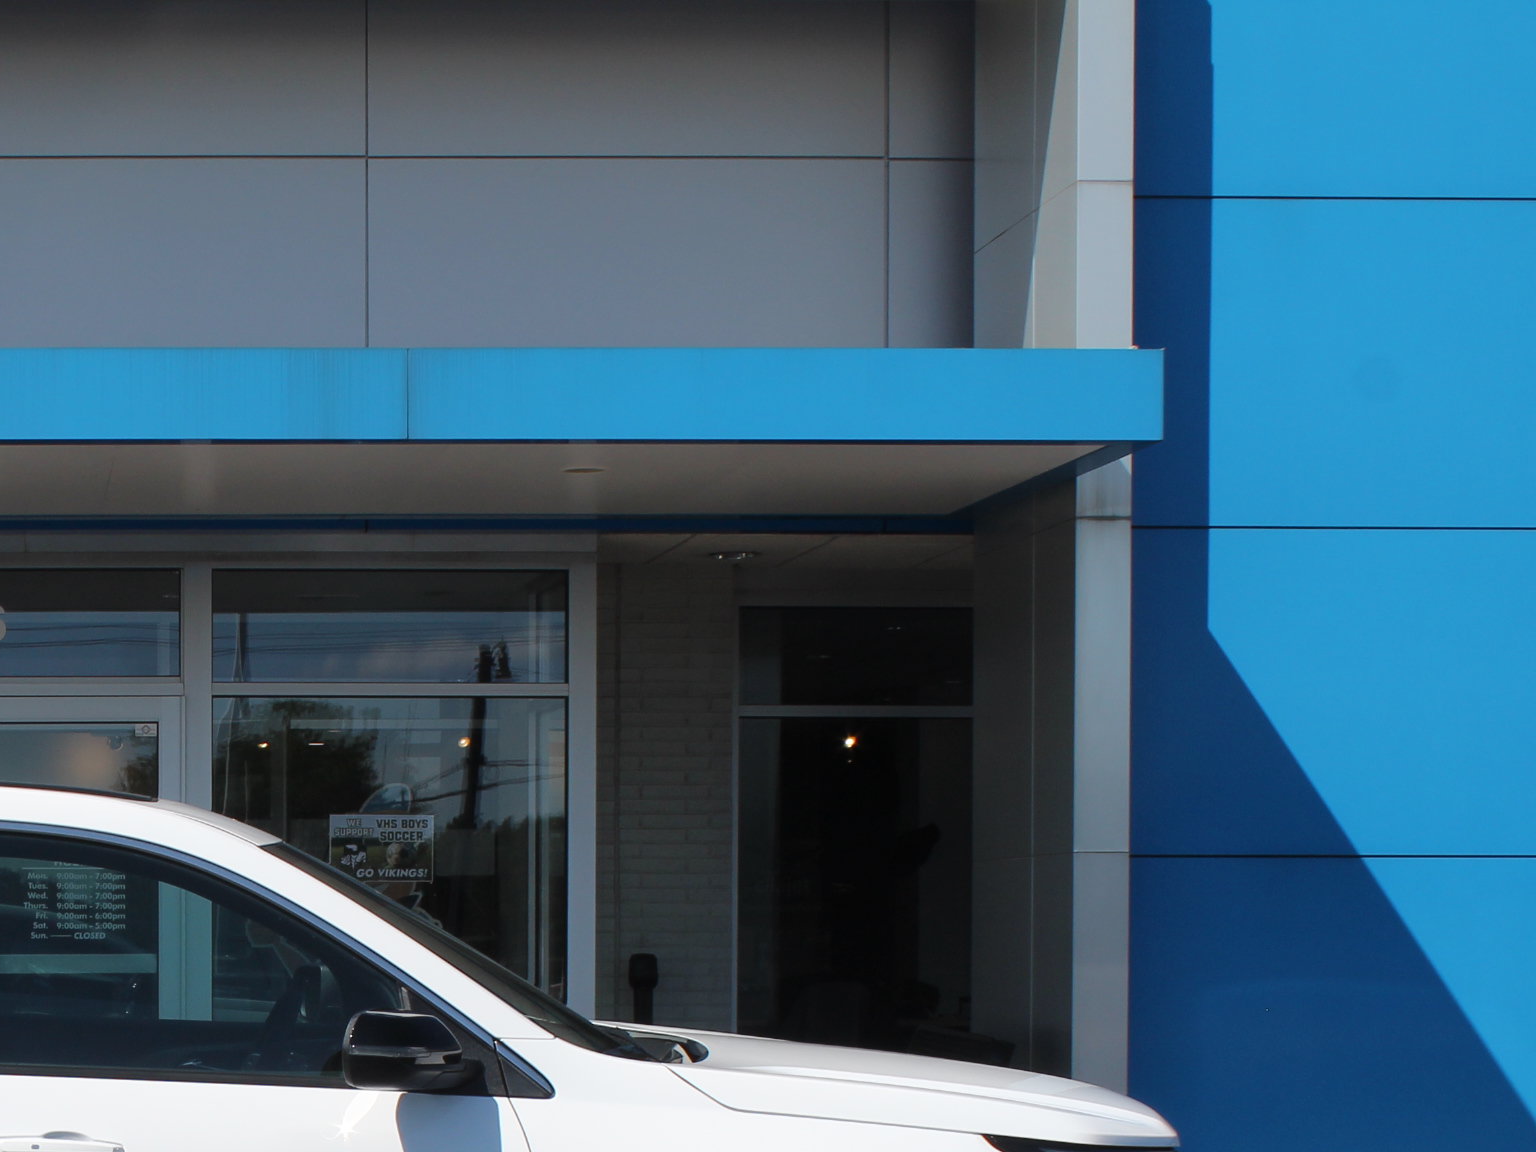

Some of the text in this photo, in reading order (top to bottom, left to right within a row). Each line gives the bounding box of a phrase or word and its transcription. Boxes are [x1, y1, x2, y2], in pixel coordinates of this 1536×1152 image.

[346, 818, 362, 826] WE
[375, 819, 429, 829] VHS BOYS
[334, 828, 374, 836] SUPPORT
[379, 831, 424, 841] SOCCER
[56, 872, 87, 880] 9:00am
[95, 872, 126, 881] 7:00pm
[356, 868, 428, 878] GO VIKINGS!
[28, 882, 48, 890] Tues.
[56, 882, 87, 890] 9:00am
[95, 882, 126, 891] 7:00pm
[27, 892, 48, 900] Wed.
[56, 892, 87, 900] 9:00am
[95, 892, 126, 901] 7:00pm
[23, 902, 48, 910] Thurs.
[56, 902, 87, 910] 9:00am
[95, 902, 126, 911] 7:00pm
[35, 912, 48, 920] Fri.
[56, 912, 87, 920] 9:00am
[95, 912, 126, 921] 6:00pm
[33, 922, 48, 930] Sat.
[56, 922, 87, 930] 9:00am
[95, 922, 126, 931] 5:00pm
[30, 932, 106, 940] Sun. CLOSED
